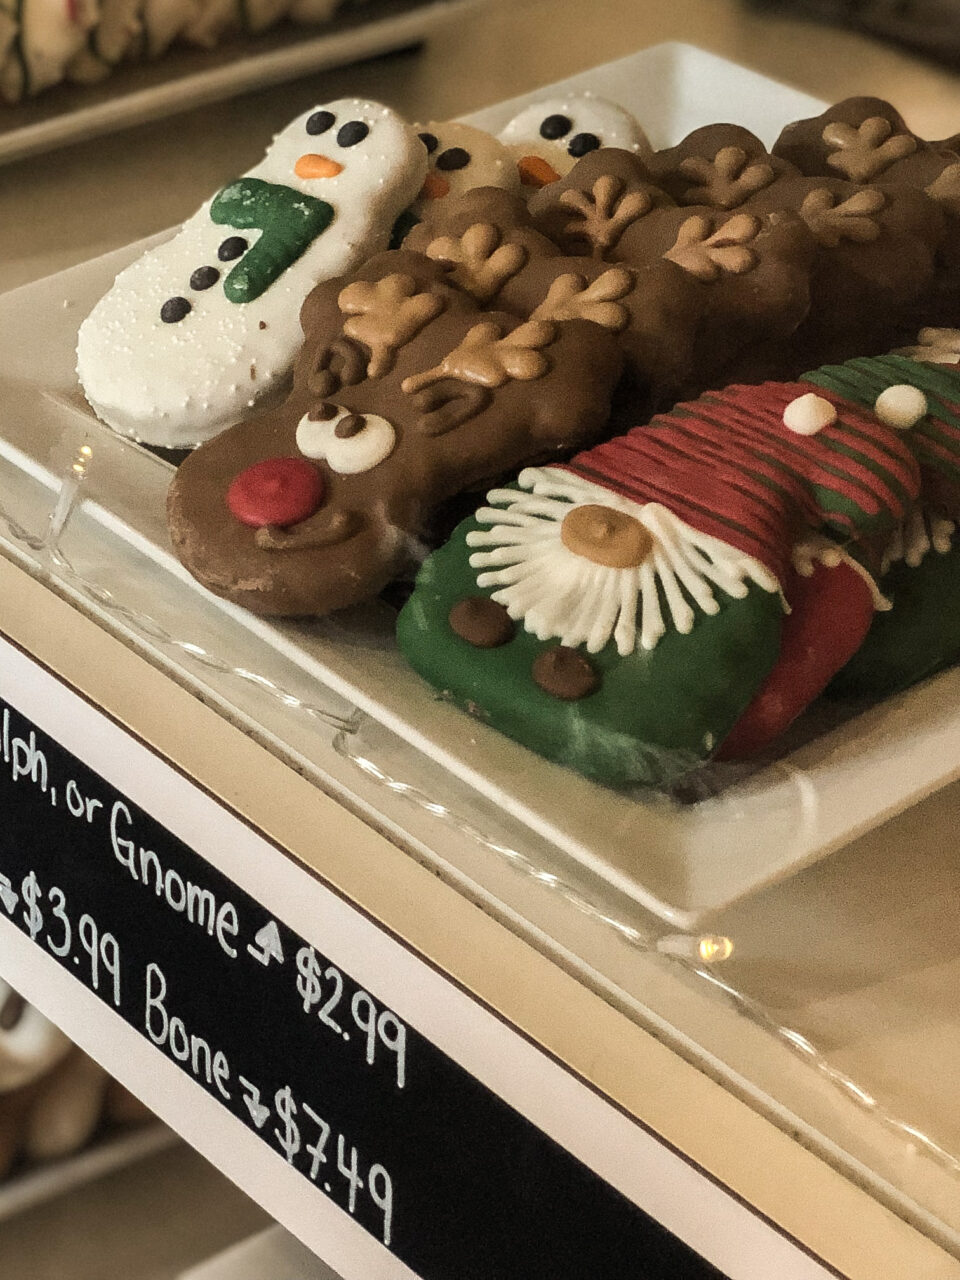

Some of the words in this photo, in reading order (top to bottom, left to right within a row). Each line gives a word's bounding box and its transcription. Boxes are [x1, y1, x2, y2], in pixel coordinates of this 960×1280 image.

[22, 870, 121, 1007] $3.99
[145, 962, 231, 1100] Bone
[274, 1084, 394, 1246] $7.49
[66, 778, 103, 826] or
[110, 799, 240, 960] Gnome
[296, 945, 408, 1089] $2.99
